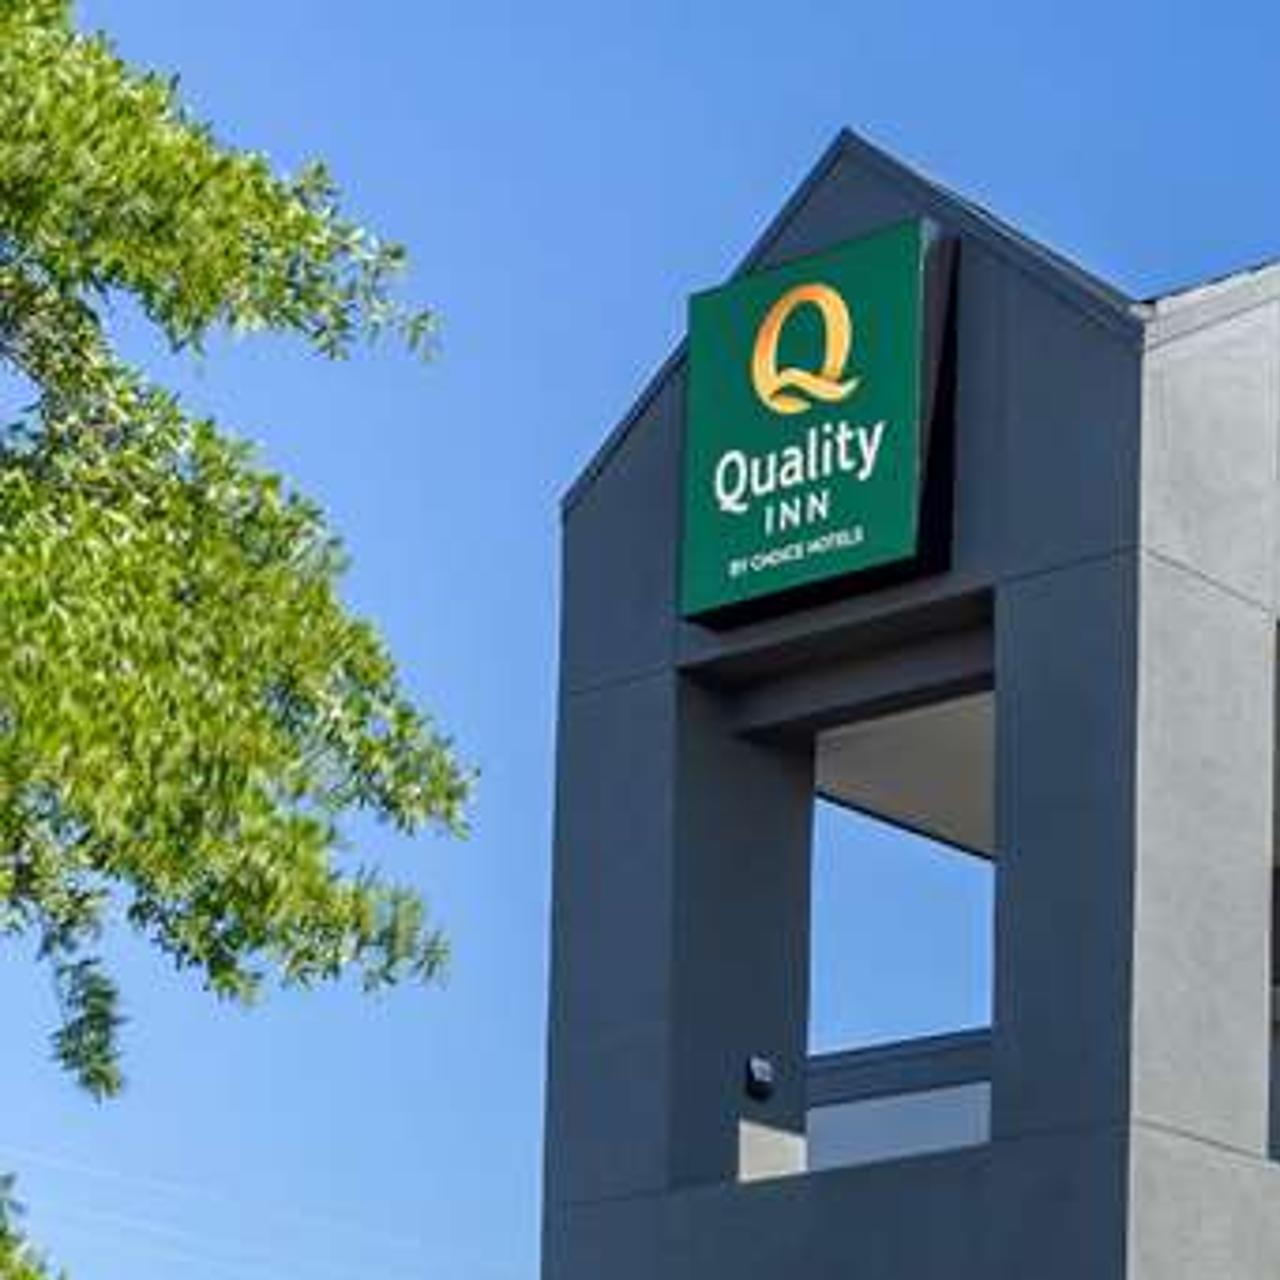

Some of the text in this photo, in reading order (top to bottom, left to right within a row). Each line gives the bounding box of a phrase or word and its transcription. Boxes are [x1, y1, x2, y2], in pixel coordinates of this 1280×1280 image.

[752, 283, 860, 413] Q
[714, 421, 885, 513] Quality
[764, 490, 831, 535] INN
[729, 525, 864, 576] BY CHOICE HOTELS
